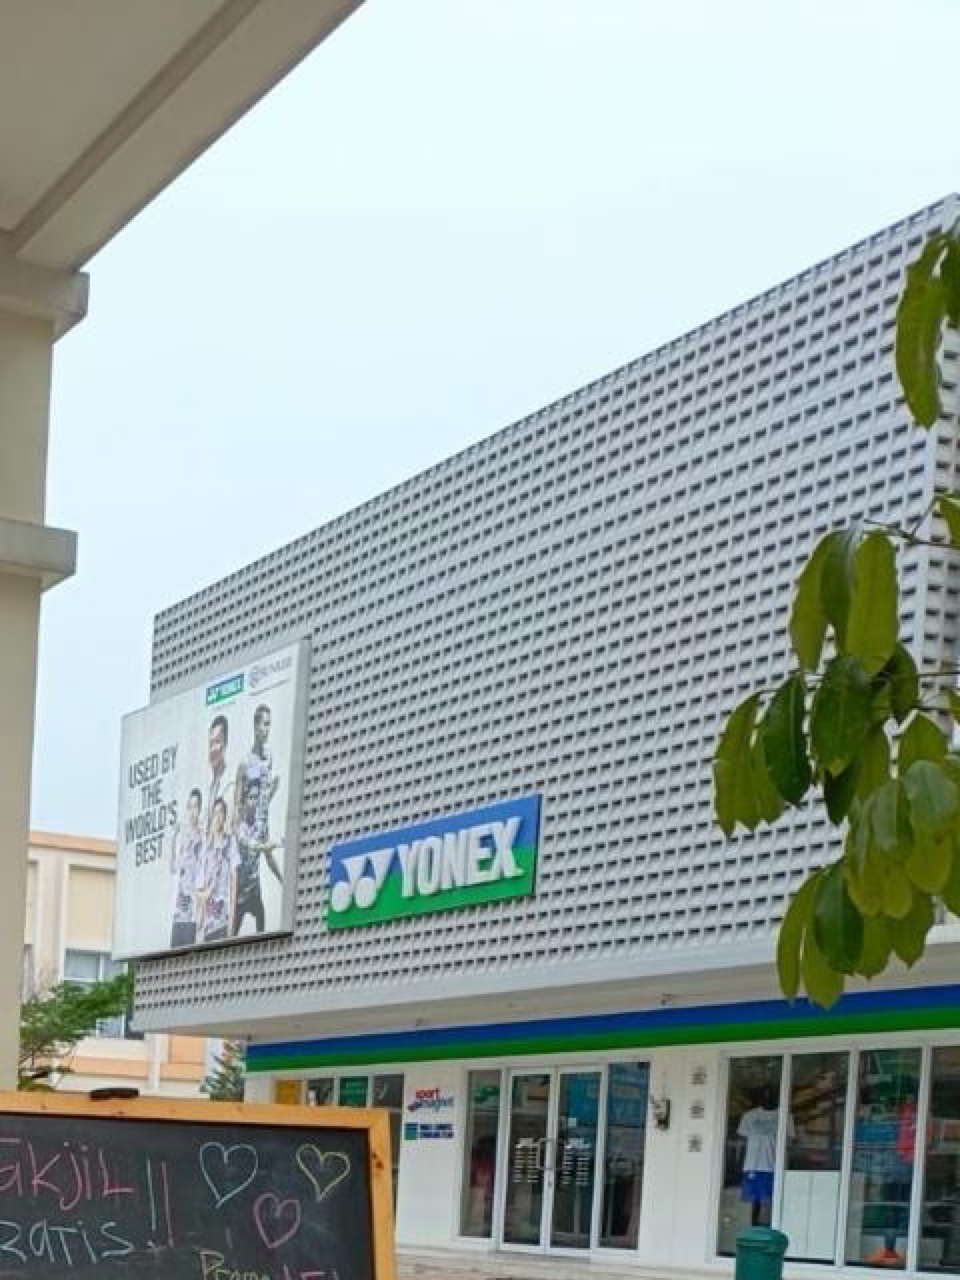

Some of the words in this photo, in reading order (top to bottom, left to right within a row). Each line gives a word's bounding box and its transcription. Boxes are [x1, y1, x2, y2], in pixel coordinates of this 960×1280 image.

[128, 752, 159, 789] USED
[161, 742, 179, 774] BY
[141, 778, 163, 810] THE
[135, 832, 165, 868] BEST
[397, 816, 526, 898] YONEX
